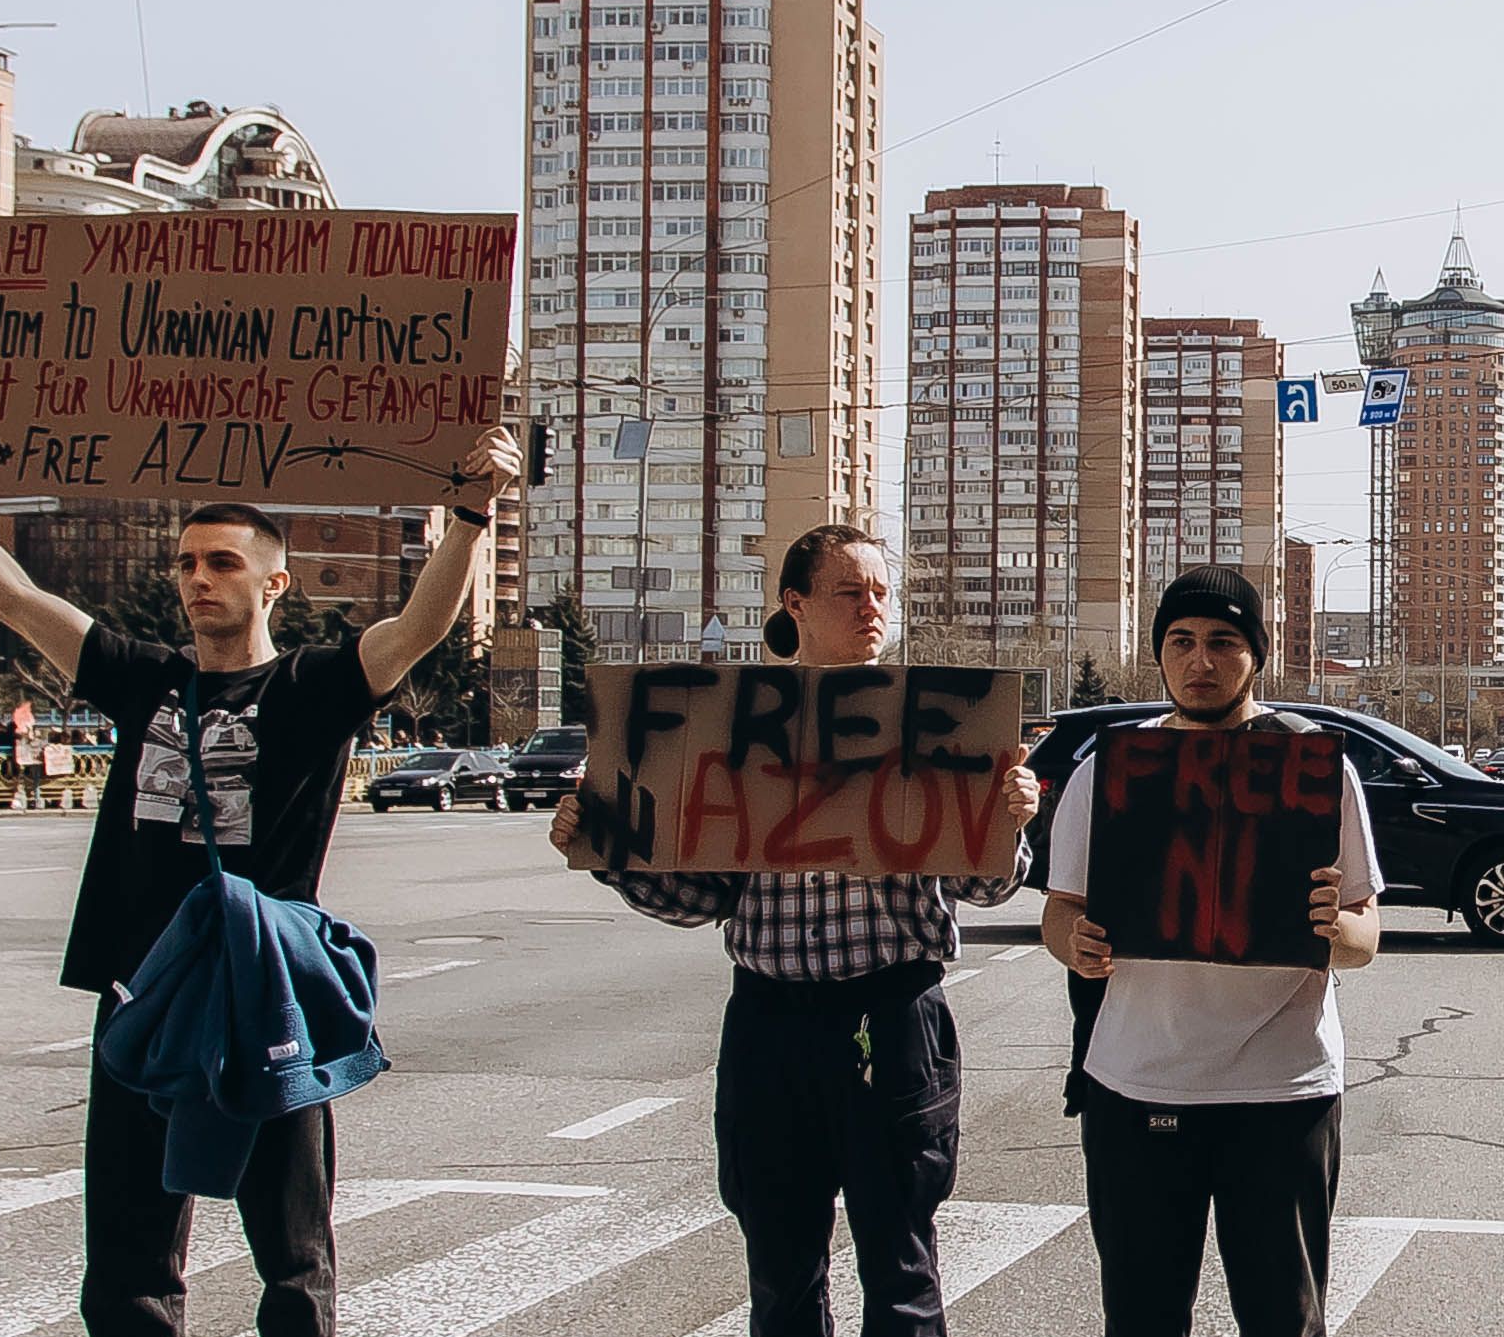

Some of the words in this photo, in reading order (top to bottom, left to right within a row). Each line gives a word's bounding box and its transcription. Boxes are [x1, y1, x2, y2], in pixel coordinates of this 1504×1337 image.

[83, 217, 331, 280] УКРАЇНСЬКИМ
[347, 221, 516, 283] ПОЛОНЕНИМ
[1332, 380, 1348, 391] 50
[19, 426, 111, 486] FREE
[131, 423, 294, 489] AZOV
[626, 666, 995, 781] FREE
[681, 744, 1012, 871] AZOV
[1105, 730, 1336, 814] FREE
